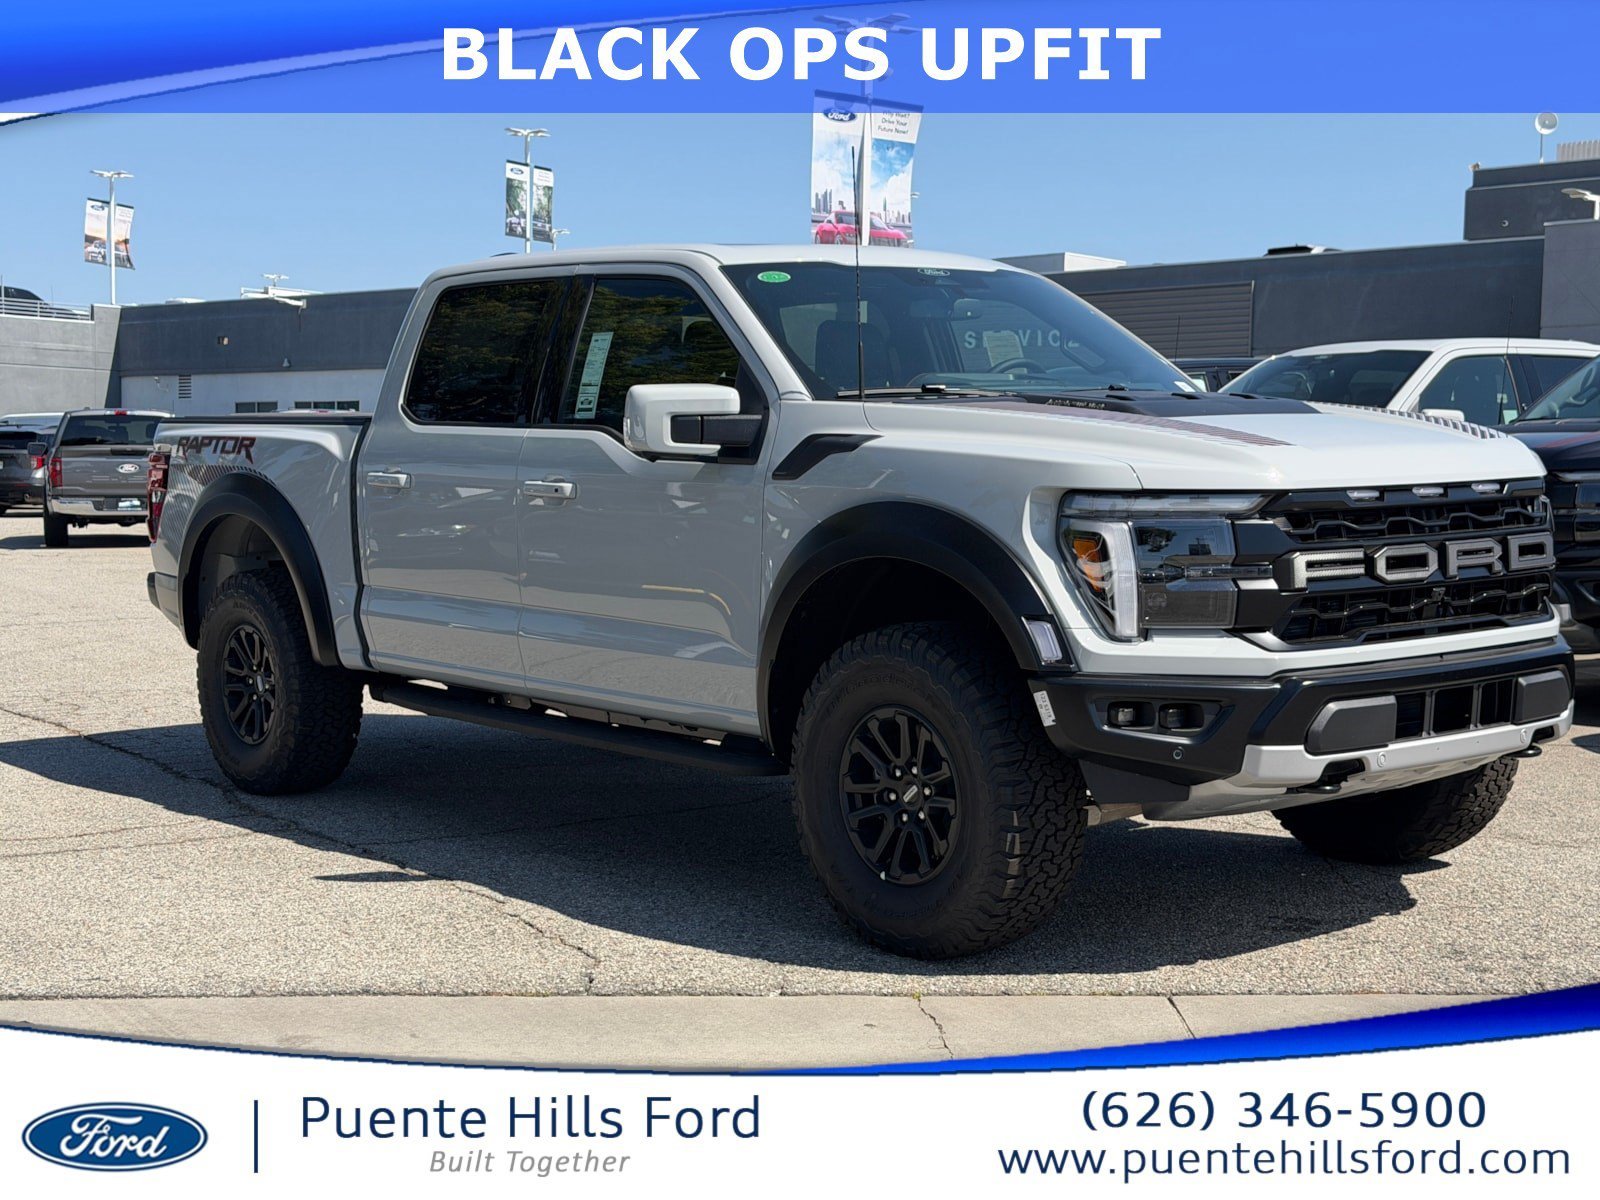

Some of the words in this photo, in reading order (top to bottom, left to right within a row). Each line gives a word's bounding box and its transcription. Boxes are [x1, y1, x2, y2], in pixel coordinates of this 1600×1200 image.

[828, 108, 851, 121] Ford
[896, 119, 908, 127] Your
[177, 436, 256, 464] RAPTOR
[1293, 531, 1556, 590] FORD
